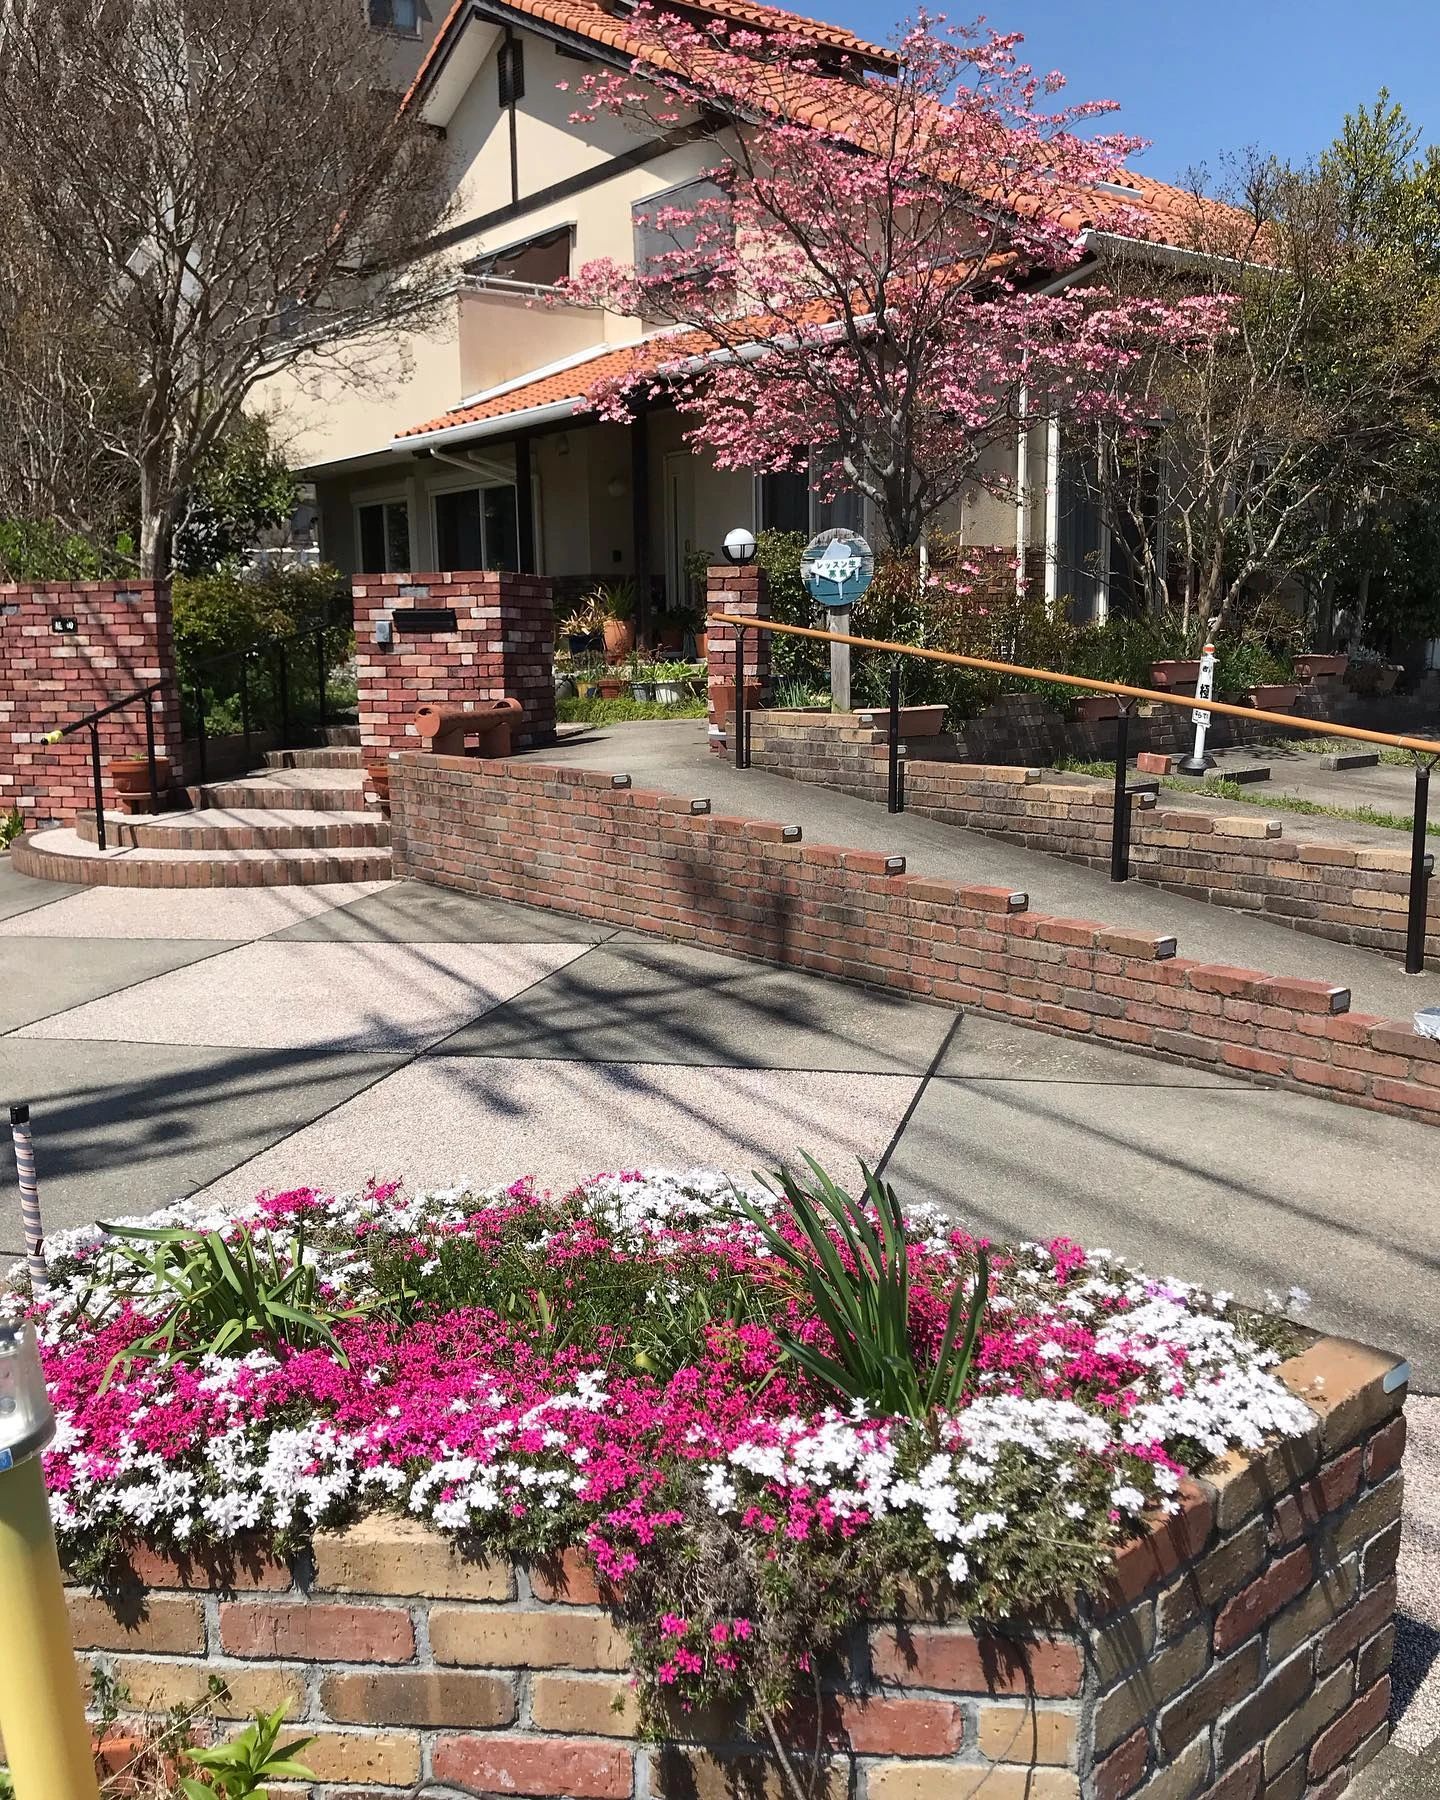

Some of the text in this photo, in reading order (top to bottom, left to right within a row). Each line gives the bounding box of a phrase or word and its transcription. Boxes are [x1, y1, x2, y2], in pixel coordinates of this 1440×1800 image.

[817, 559, 856, 569] レッスン生
